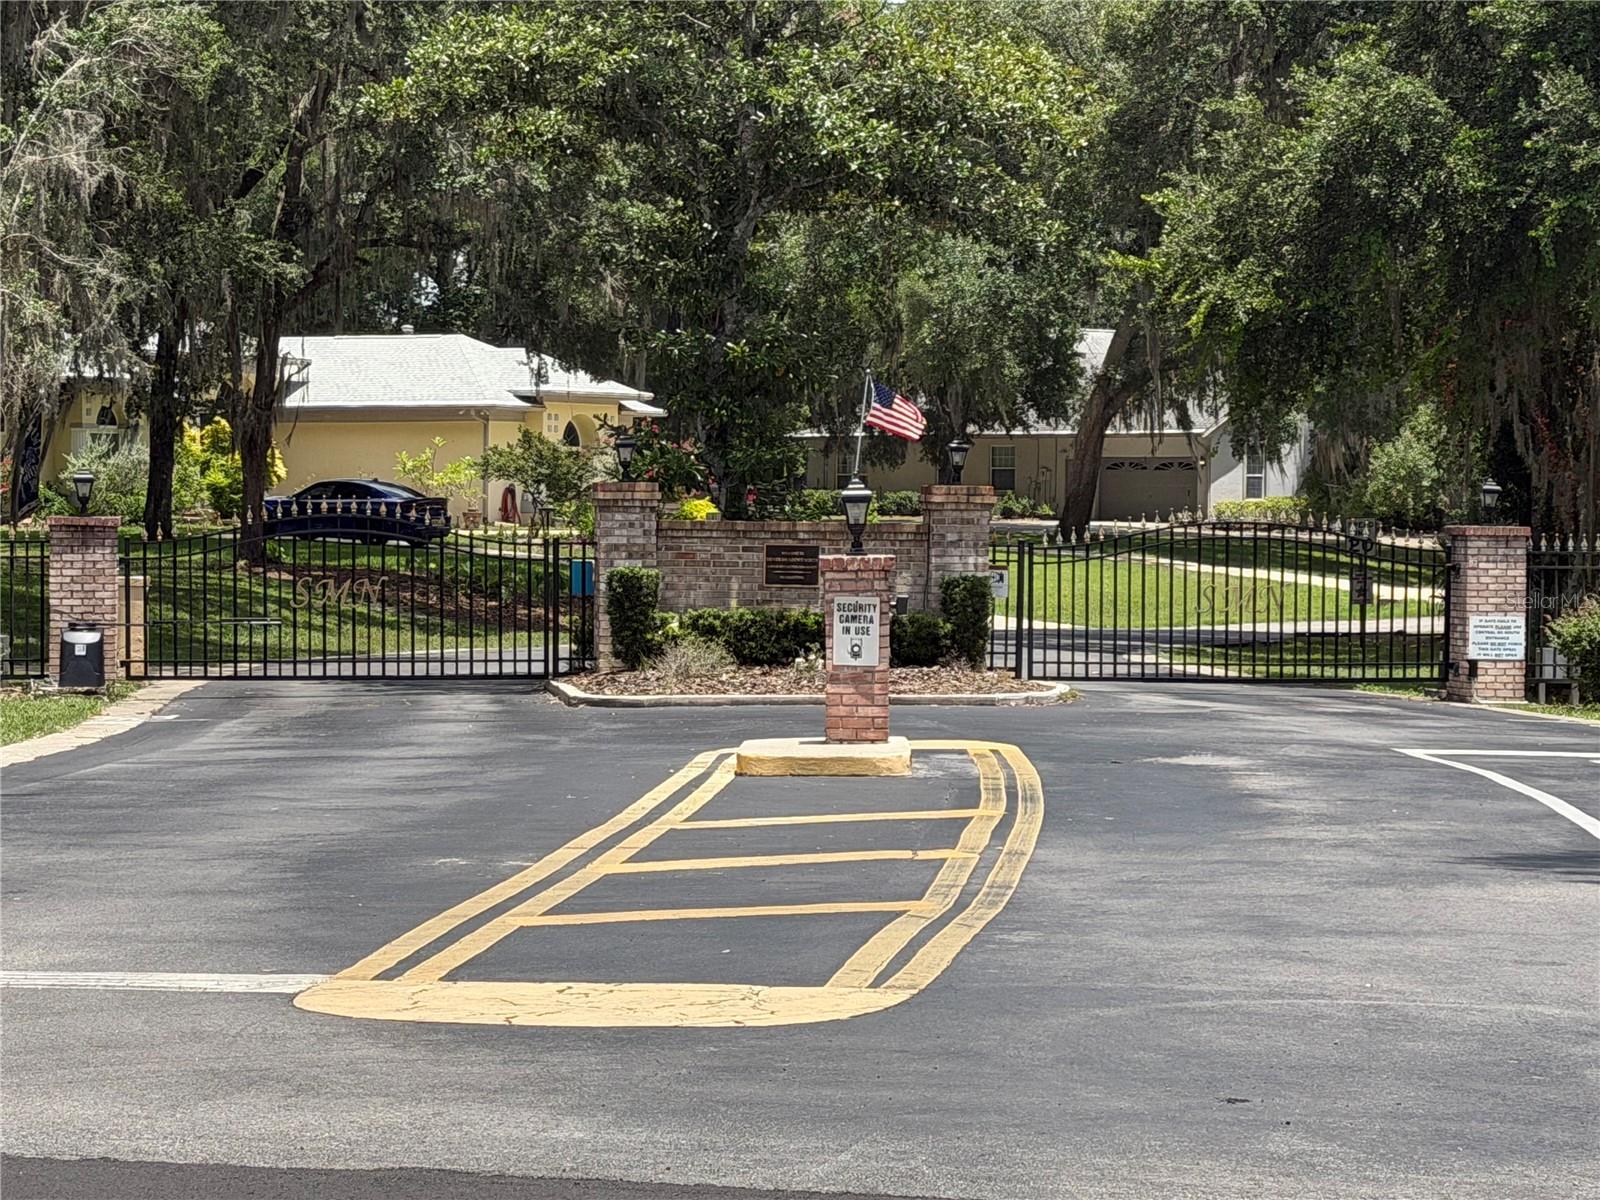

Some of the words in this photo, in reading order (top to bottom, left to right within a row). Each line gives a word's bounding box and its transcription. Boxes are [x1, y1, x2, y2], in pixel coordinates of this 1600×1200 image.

[290, 576, 389, 608] SMN
[836, 602, 877, 613] SECURITY
[839, 614, 874, 624] CAMERA
[842, 626, 851, 635] IN
[855, 626, 871, 636] USE
